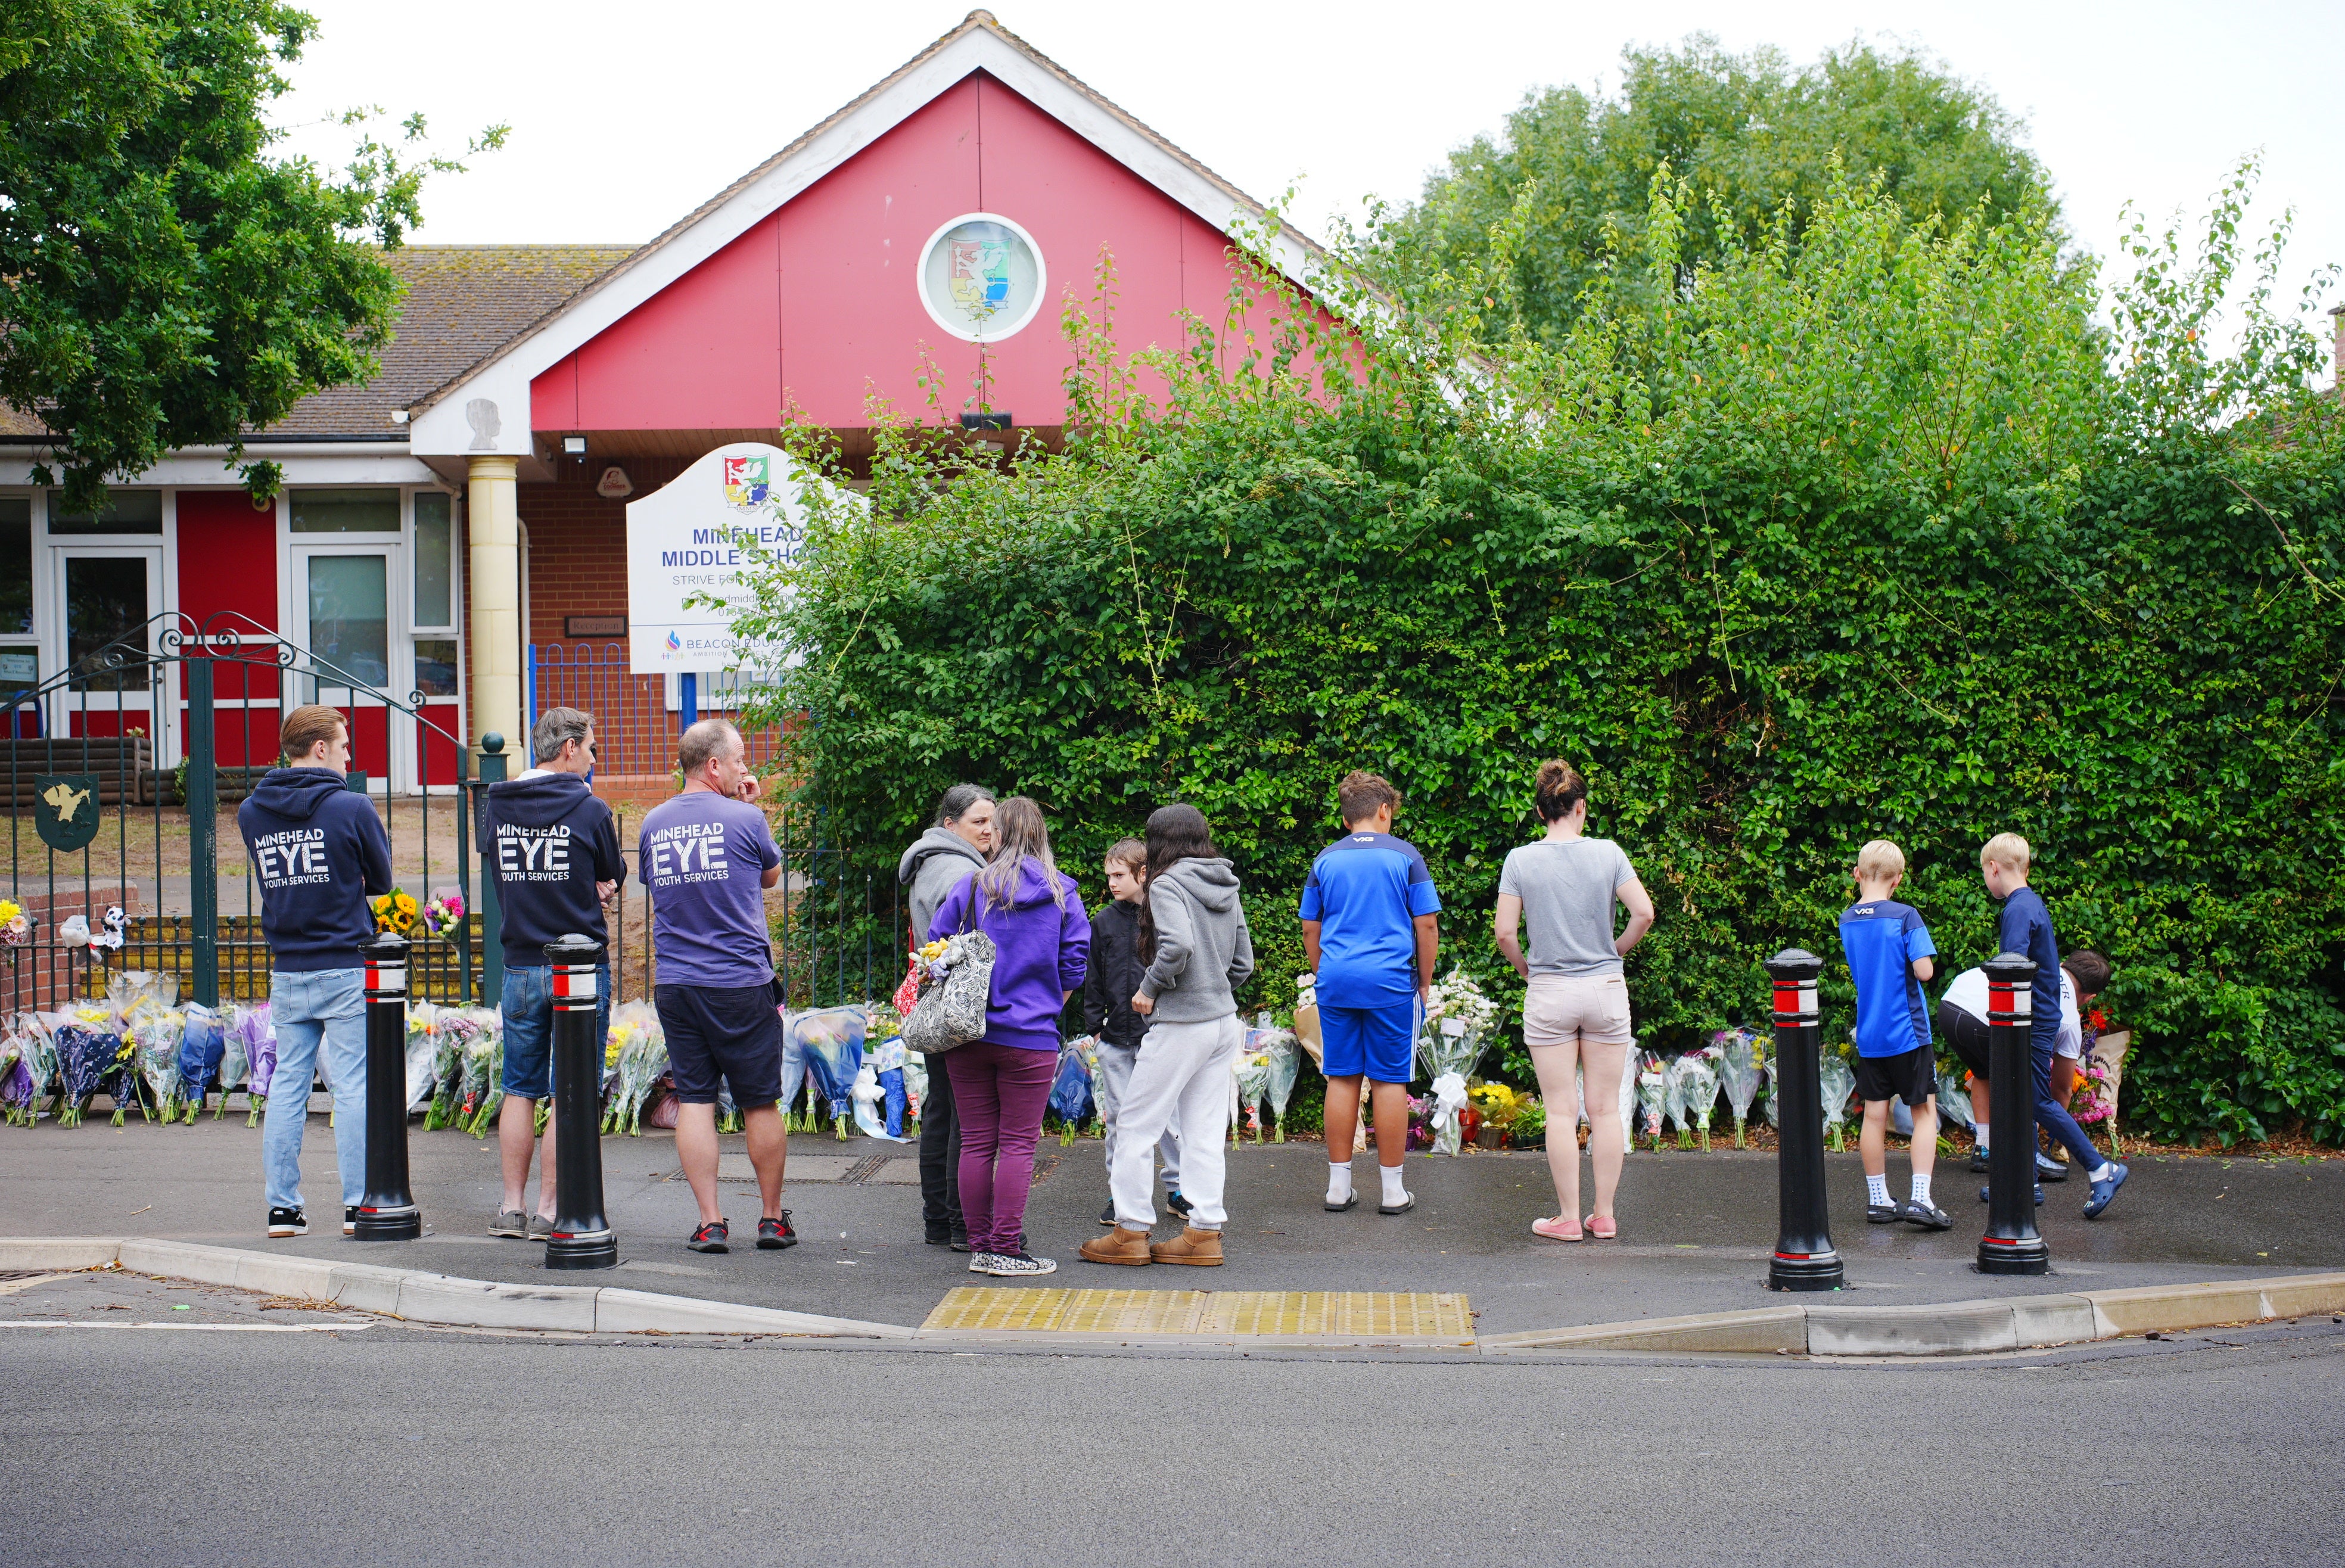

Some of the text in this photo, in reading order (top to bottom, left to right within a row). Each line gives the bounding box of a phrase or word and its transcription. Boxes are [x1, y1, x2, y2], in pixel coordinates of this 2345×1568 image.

[693, 527, 802, 545] MINEHEAD
[663, 547, 820, 567] MIDDLE SCHO
[673, 575, 715, 585] STRIVE
[574, 621, 618, 631] Reception
[687, 638, 788, 649] BEACON EDUCA
[254, 828, 324, 849] MINEHEAD
[497, 823, 571, 838] MINEHEAD
[651, 822, 724, 844] MINEHEAD
[257, 841, 329, 879] EYE
[497, 838, 570, 870] EYE
[651, 836, 728, 876] EYE
[264, 874, 330, 889] YOUTH SERVICES
[528, 871, 570, 881] SERVICES
[654, 870, 729, 887] YOUTH SERVICES
